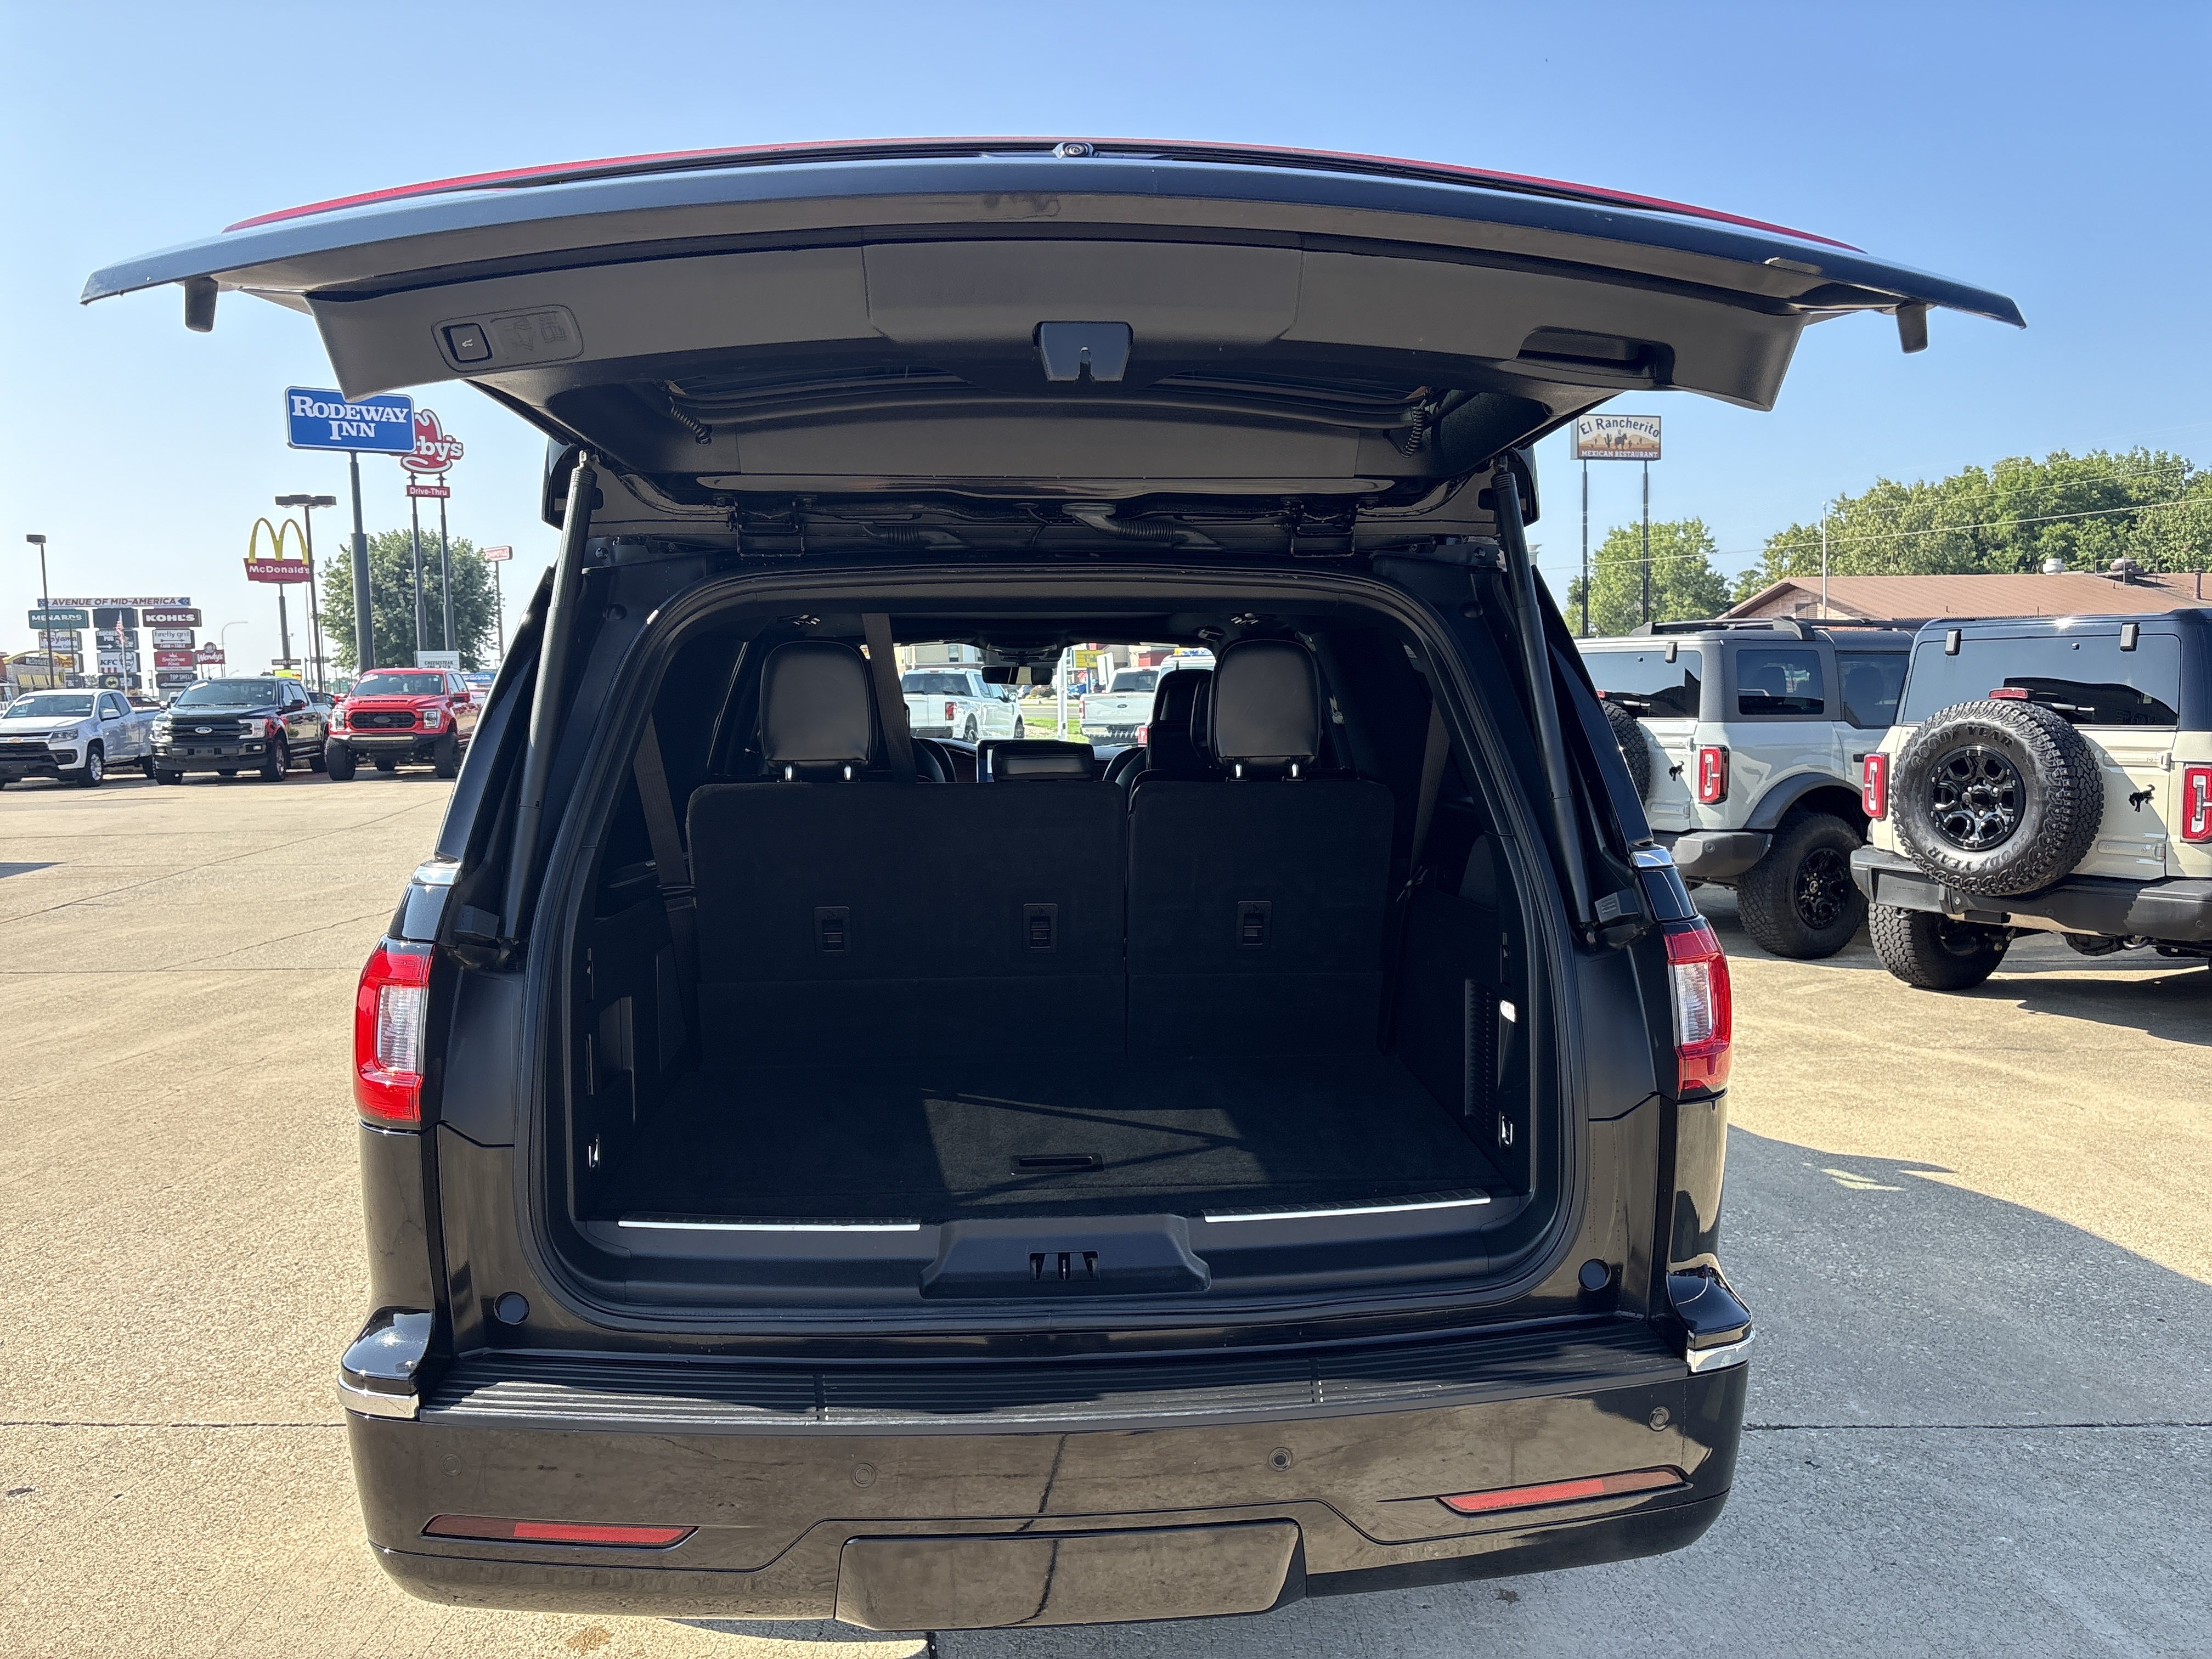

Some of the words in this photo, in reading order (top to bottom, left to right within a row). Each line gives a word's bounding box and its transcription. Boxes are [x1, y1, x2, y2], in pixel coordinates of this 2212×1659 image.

[291, 395, 409, 423] RODEWAY
[329, 420, 376, 441] INN
[1579, 421, 1593, 435] El
[1595, 417, 1660, 438] Rancherito
[414, 436, 462, 460] by's
[410, 487, 447, 496] Drive-Thru
[249, 565, 310, 574] McDonald's
[145, 614, 195, 622] KOHL'S
[154, 630, 175, 639] firefly
[177, 630, 190, 639] grill
[197, 652, 223, 663] Wendy's
